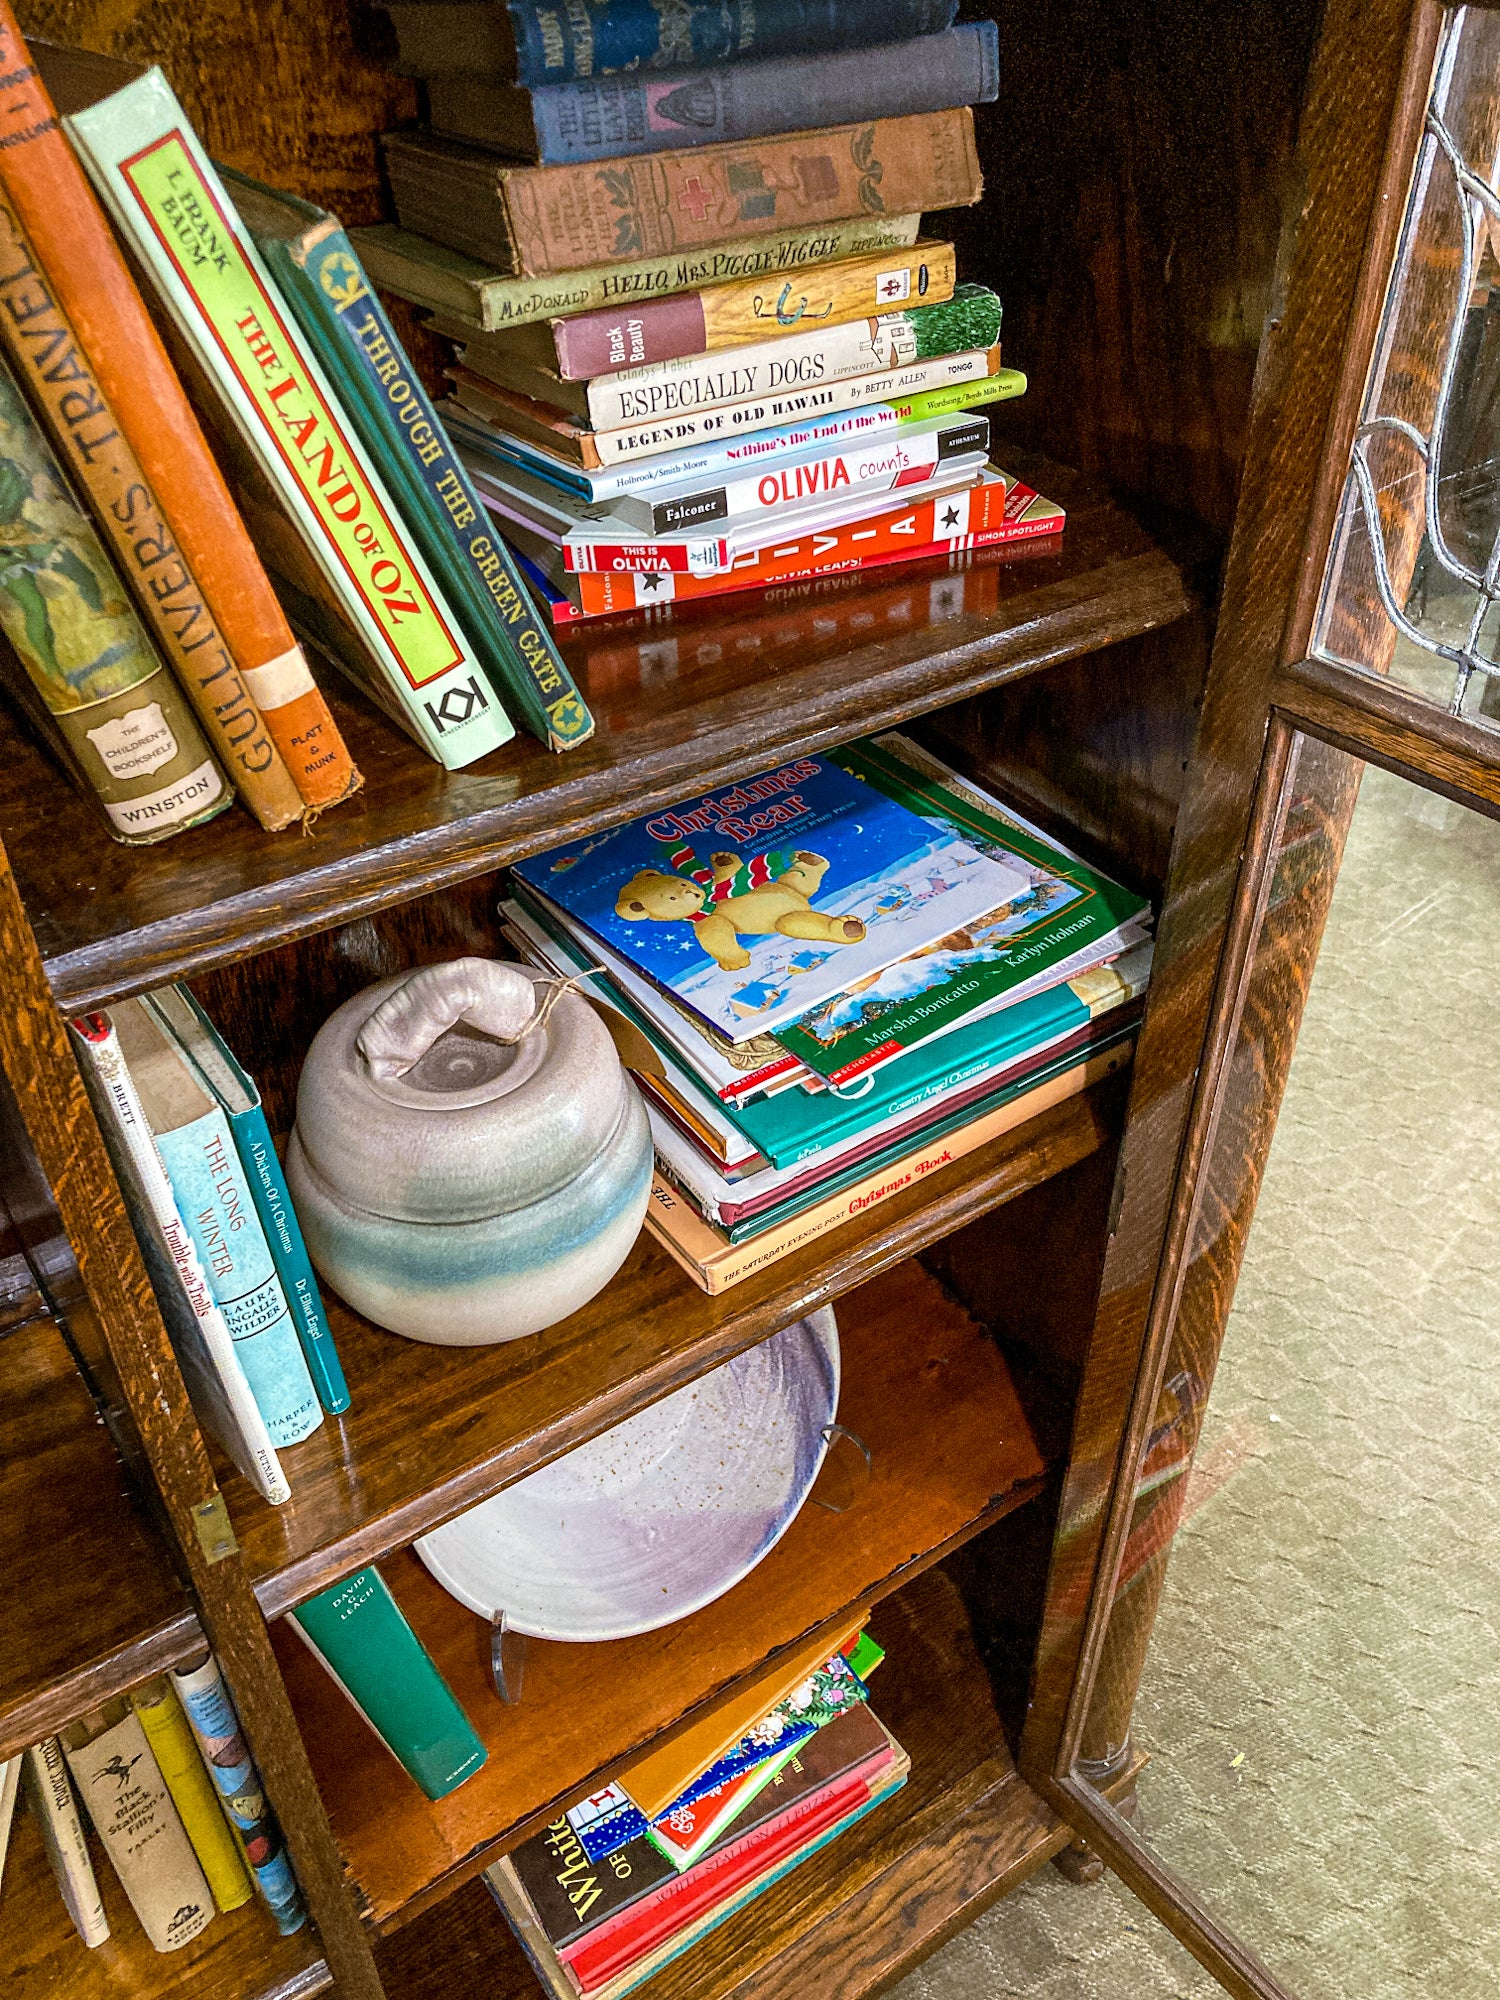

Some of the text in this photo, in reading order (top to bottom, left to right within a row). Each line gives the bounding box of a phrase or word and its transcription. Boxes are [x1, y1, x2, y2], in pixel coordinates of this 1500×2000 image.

[161, 196, 208, 268] BAUM
[181, 191, 231, 275] FRANK
[600, 274, 669, 298] HELLO,
[605, 326, 626, 364] Black
[626, 318, 646, 362] Beauty
[616, 363, 657, 383] Gladys
[618, 353, 875, 420] ESPECIALLY DOGS LIPPINCOTT
[616, 361, 973, 451] LEGENDS OF OLD HAWAII By BETTY ALLEN TONGG
[726, 431, 787, 460] Nothing's
[789, 431, 810, 446] the
[812, 426, 838, 440] End
[842, 419, 854, 432] of
[855, 414, 876, 429] the
[877, 405, 913, 422] World
[235, 306, 421, 625] THE LAND OF OZ
[665, 500, 717, 522] Falconer
[757, 457, 852, 506] OLIVIA
[858, 444, 910, 479] counts
[357, 313, 564, 695] THROUGH THE GREEN GATE
[977, 531, 1004, 543] SIMON
[1007, 522, 1055, 537] SPOTLIGHT
[611, 557, 672, 572] OLIVIA
[622, 546, 658, 556] THIS IS
[109, 483, 274, 774] GULLIVER'S
[104, 727, 168, 759] CHILDREN'S
[120, 724, 140, 737] THE
[289, 723, 324, 747] PLATT
[112, 741, 174, 772] BOOKSHELF
[304, 751, 338, 775] MUNK
[310, 745, 320, 755] &
[121, 777, 210, 823] WINSTON
[646, 758, 823, 843] Christmas
[715, 794, 813, 844] Bear
[864, 1018, 920, 1047] Marsha
[916, 980, 980, 1018] Bonicatto
[1003, 939, 1049, 969] Karlyn
[1045, 914, 1096, 950] Holman
[740, 1057, 792, 1084] SCHOLASTIC
[840, 1041, 896, 1077] SCHOLASTIC
[888, 1093, 922, 1114] Country
[923, 1077, 948, 1098] Angel
[949, 1062, 990, 1085] Christmas
[249, 1141, 263, 1152] A
[203, 1134, 247, 1232] THE LONG
[252, 1150, 273, 1190] Dickens
[270, 1202, 281, 1212] A
[723, 1150, 956, 1283] THE SATURDAY EVENING POST Christmas Book
[196, 1207, 235, 1279] WINTER
[272, 1209, 294, 1254] Christmas
[112, 1084, 276, 1485] BRETT Trouble with Trolls PUTNAM
[295, 1278, 307, 1293] Dr.
[223, 1286, 275, 1316] LAURA
[226, 1294, 278, 1325] INGALLS
[230, 1305, 282, 1335] WILDER
[304, 1315, 324, 1341] Engel
[266, 1399, 314, 1429] HARPER
[282, 1420, 311, 1441] ROW
[332, 1576, 366, 1608] DAVID
[340, 1588, 375, 1620] LEACH
[114, 1784, 142, 1805] The
[114, 1789, 152, 1820] Black
[107, 1791, 167, 1836] Stallion's
[126, 1812, 156, 1836] Filly
[608, 1854, 632, 1879] OF
[656, 1872, 700, 1905] WHITE
[704, 1830, 768, 1876] STALLION
